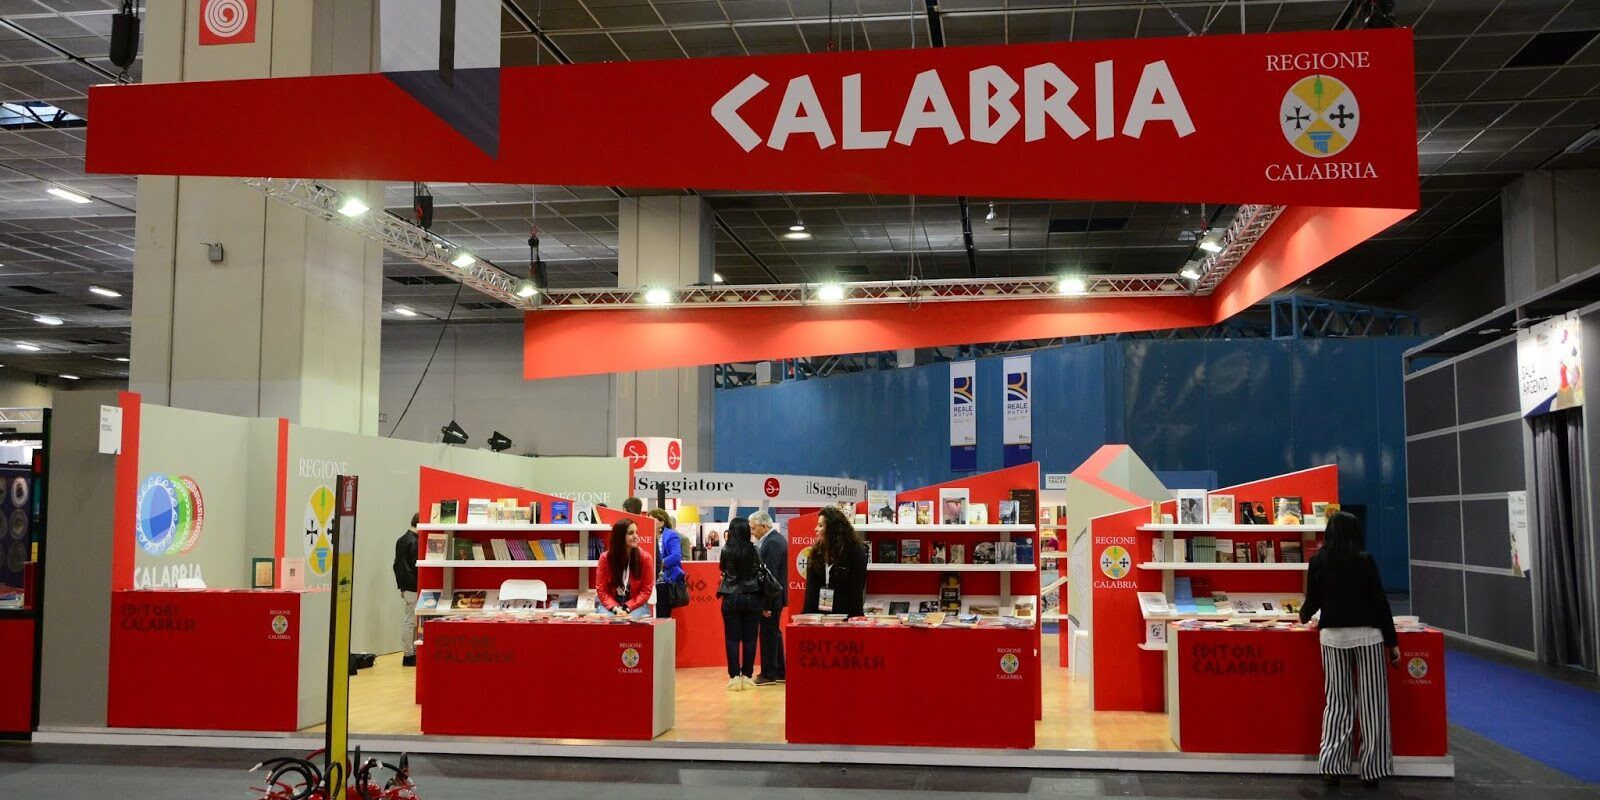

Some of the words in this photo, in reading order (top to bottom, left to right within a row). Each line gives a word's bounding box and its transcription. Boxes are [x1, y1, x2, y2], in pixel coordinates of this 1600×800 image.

[1266, 51, 1370, 72] REGIONE
[710, 59, 1195, 153] CALABRIA
[1265, 161, 1378, 181] CALABRIA
[1522, 376, 1549, 395] ARGENTO
[299, 458, 349, 478] REGIONE
[633, 476, 734, 494] lSaggiatore
[806, 481, 858, 498] ilSaggiatore
[792, 537, 818, 545] REGI
[1095, 536, 1136, 545] REGIONE
[1093, 580, 1138, 589] CALABRIA
